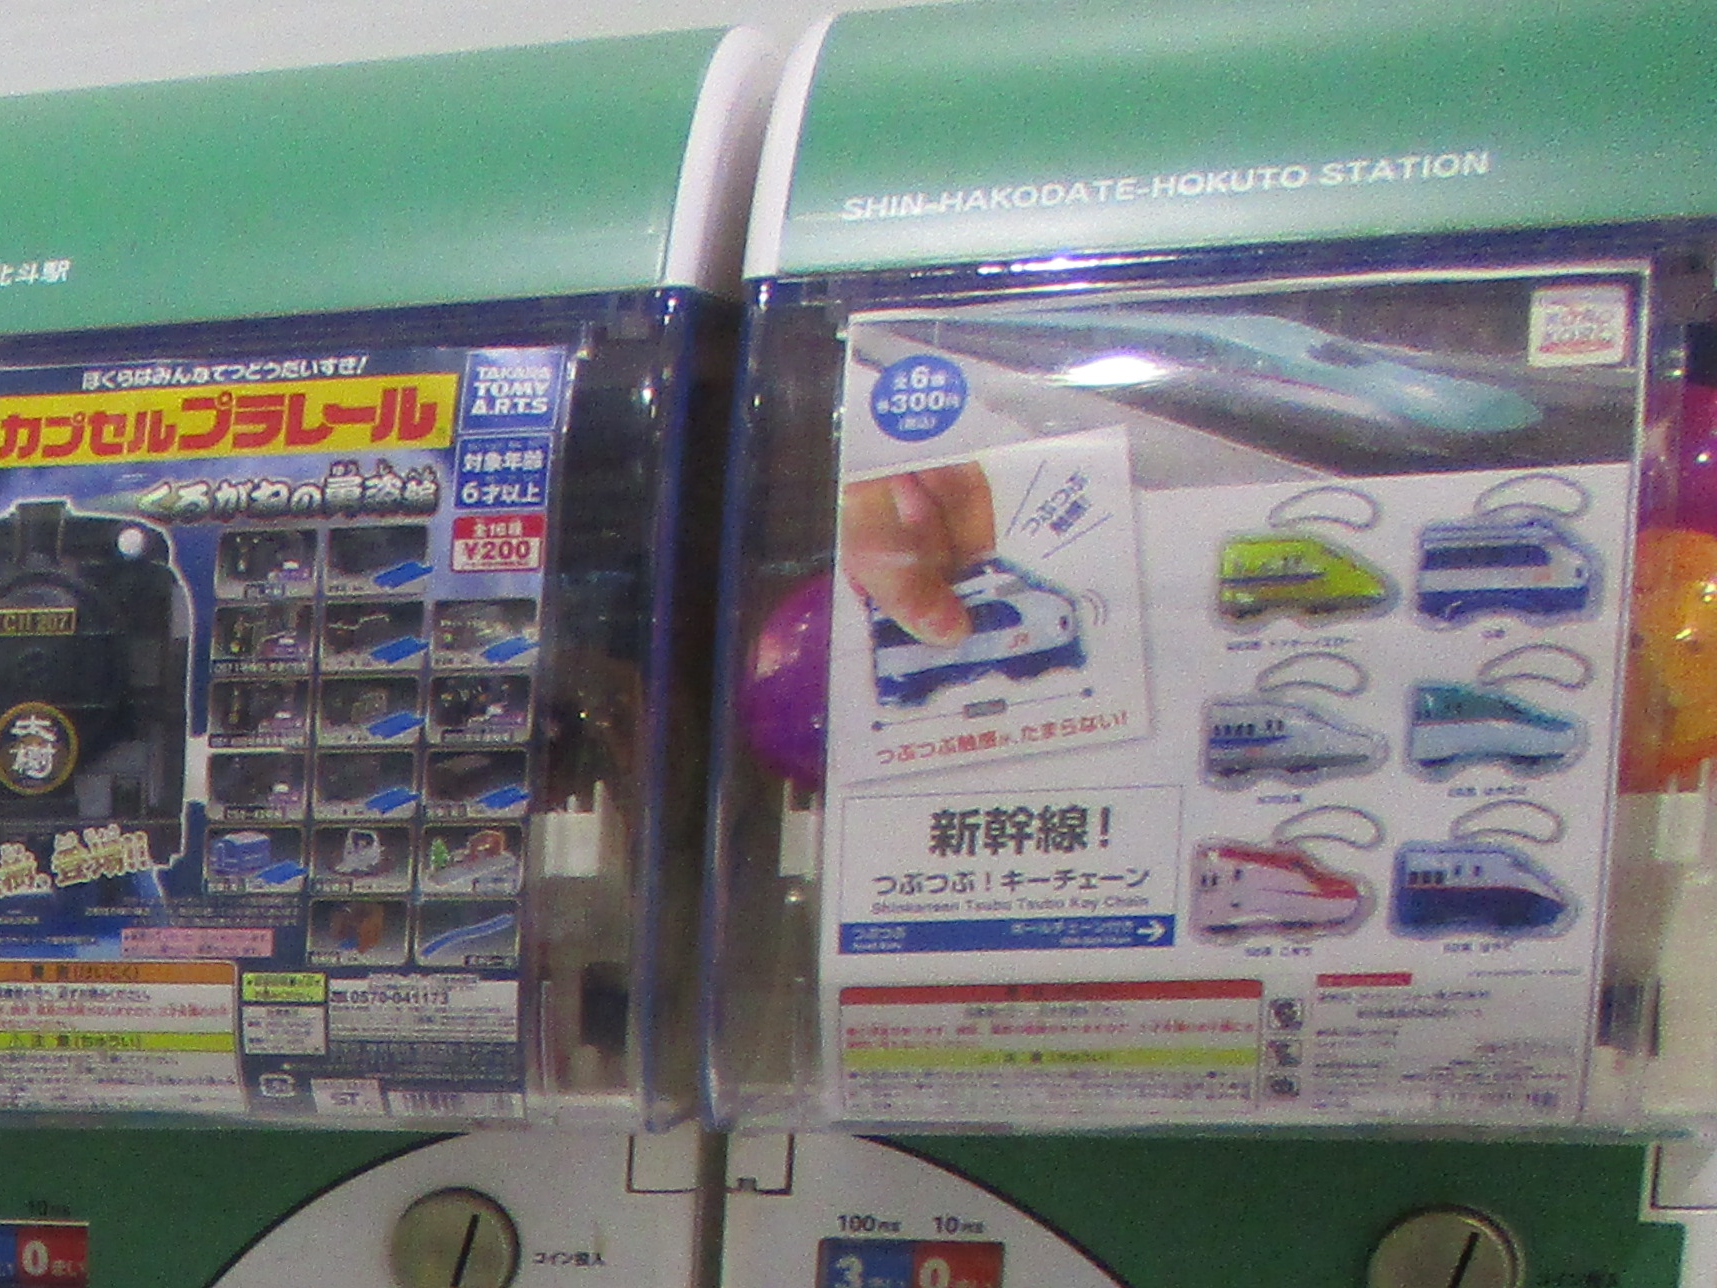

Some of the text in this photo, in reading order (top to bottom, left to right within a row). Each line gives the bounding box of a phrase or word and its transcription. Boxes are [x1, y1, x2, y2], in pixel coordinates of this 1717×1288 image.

[841, 151, 1492, 222] SHIN-HAKODATE-HOKUTO STATION
[473, 381, 552, 401] TOMY
[462, 449, 544, 476] 対象年齢
[461, 479, 542, 505] 6才以上
[464, 538, 532, 563] ¥200
[928, 804, 1112, 857] 新幹線!
[871, 867, 1151, 896] つぶつぶ!キーチェーン
